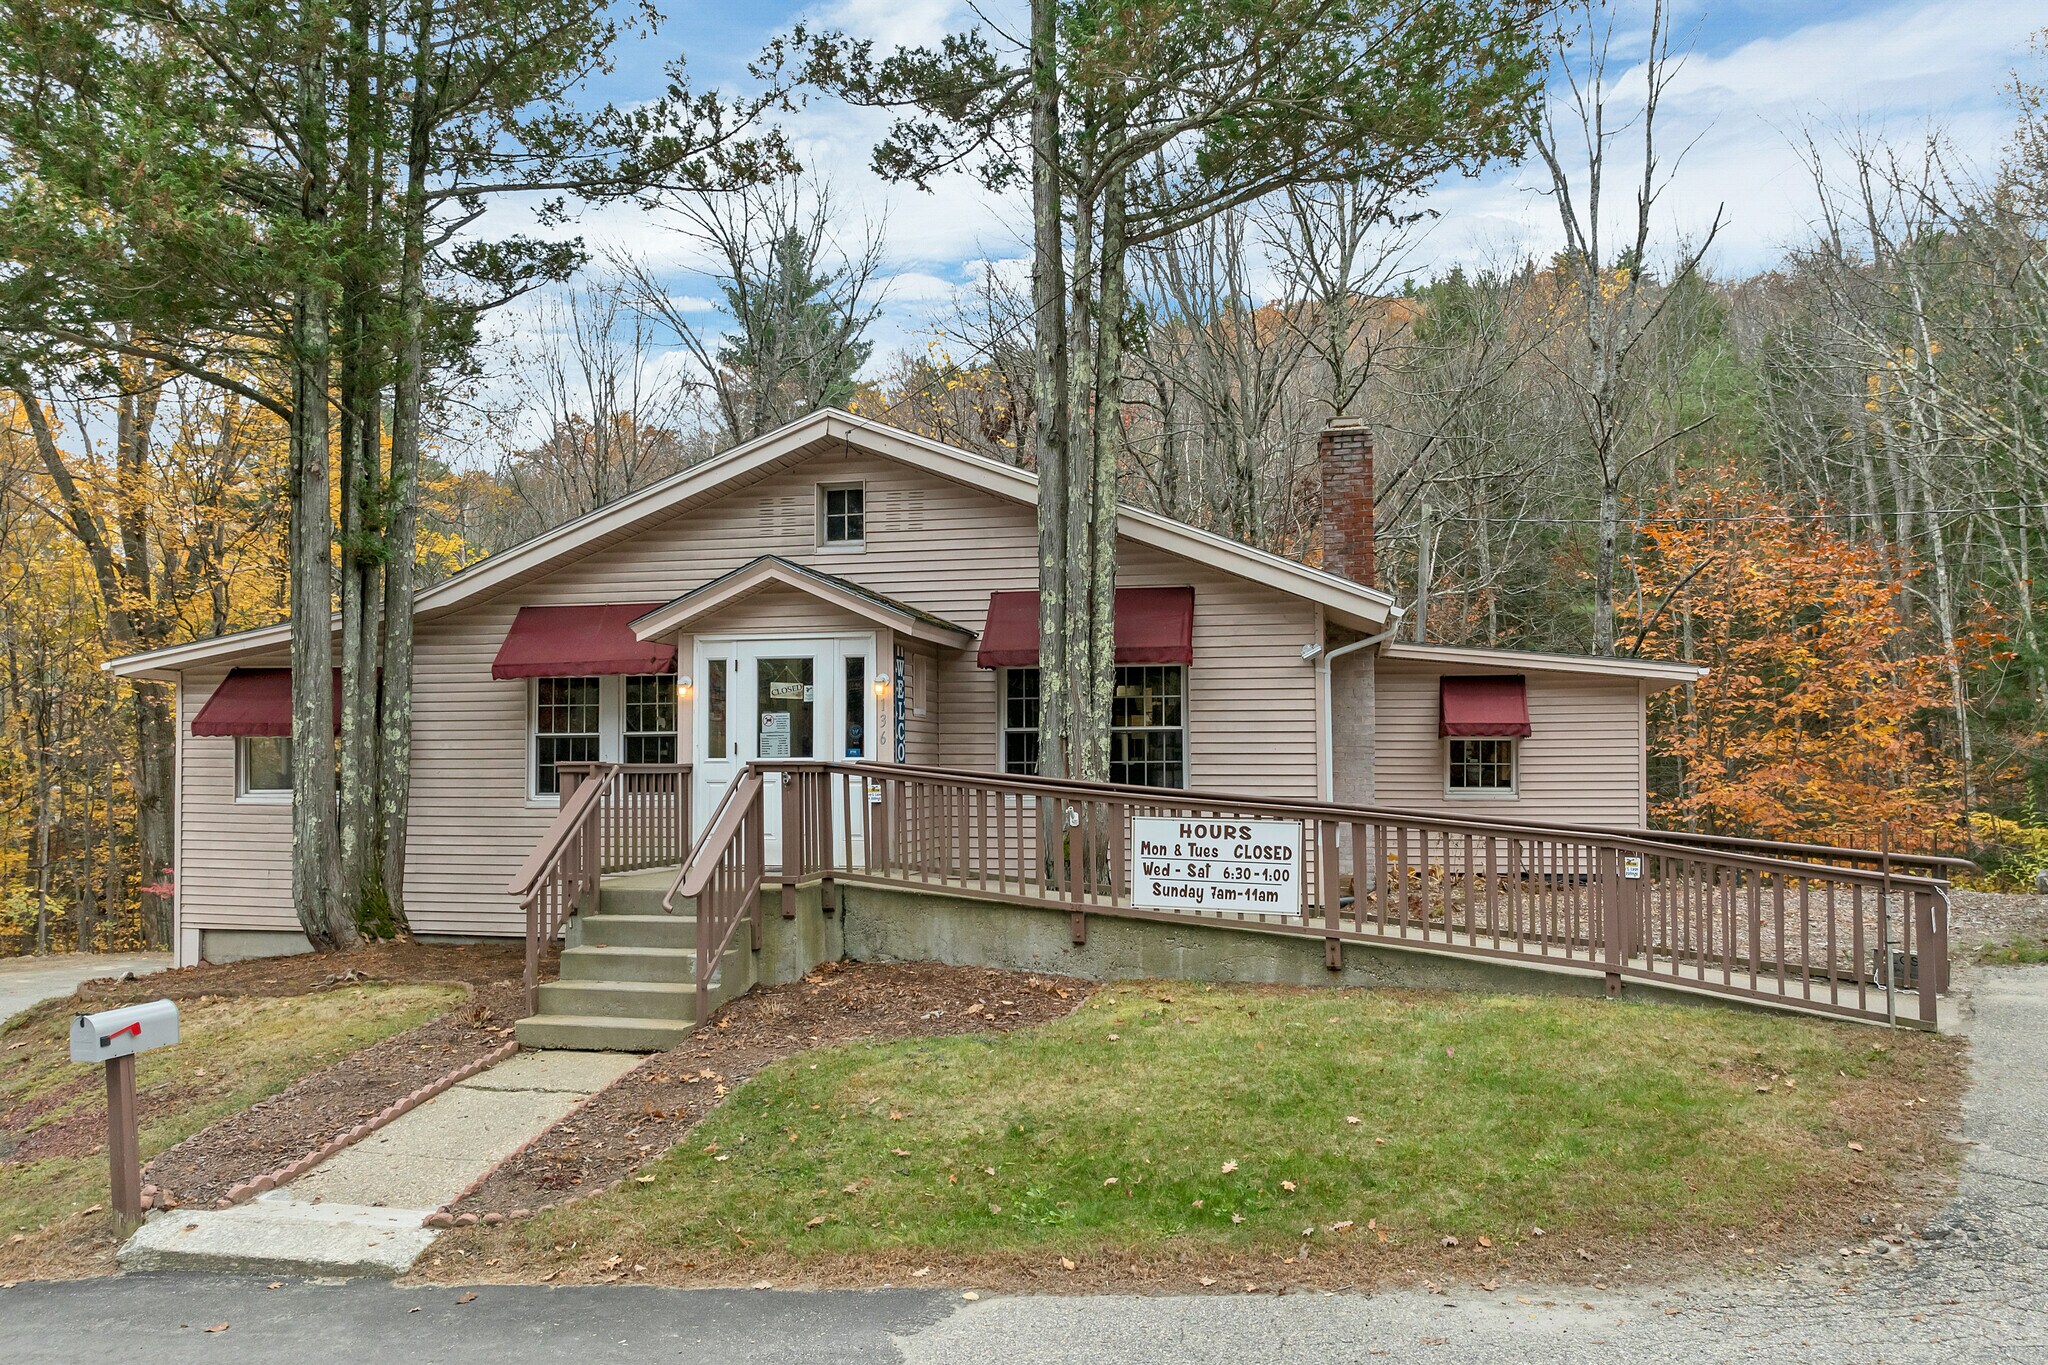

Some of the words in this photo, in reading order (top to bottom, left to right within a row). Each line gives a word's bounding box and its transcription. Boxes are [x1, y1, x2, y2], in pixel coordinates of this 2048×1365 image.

[771, 684, 803, 696] CLOSED
[1179, 823, 1252, 840] HOURS
[1141, 841, 1167, 856] Mon
[1174, 844, 1182, 856] &
[1188, 842, 1219, 858] Tues
[1233, 844, 1292, 861] CLOSED
[1142, 862, 1170, 877] Wed
[1187, 863, 1211, 879] Sat
[1152, 882, 1204, 904] Sunday
[1210, 886, 1279, 903] 7am-11am
